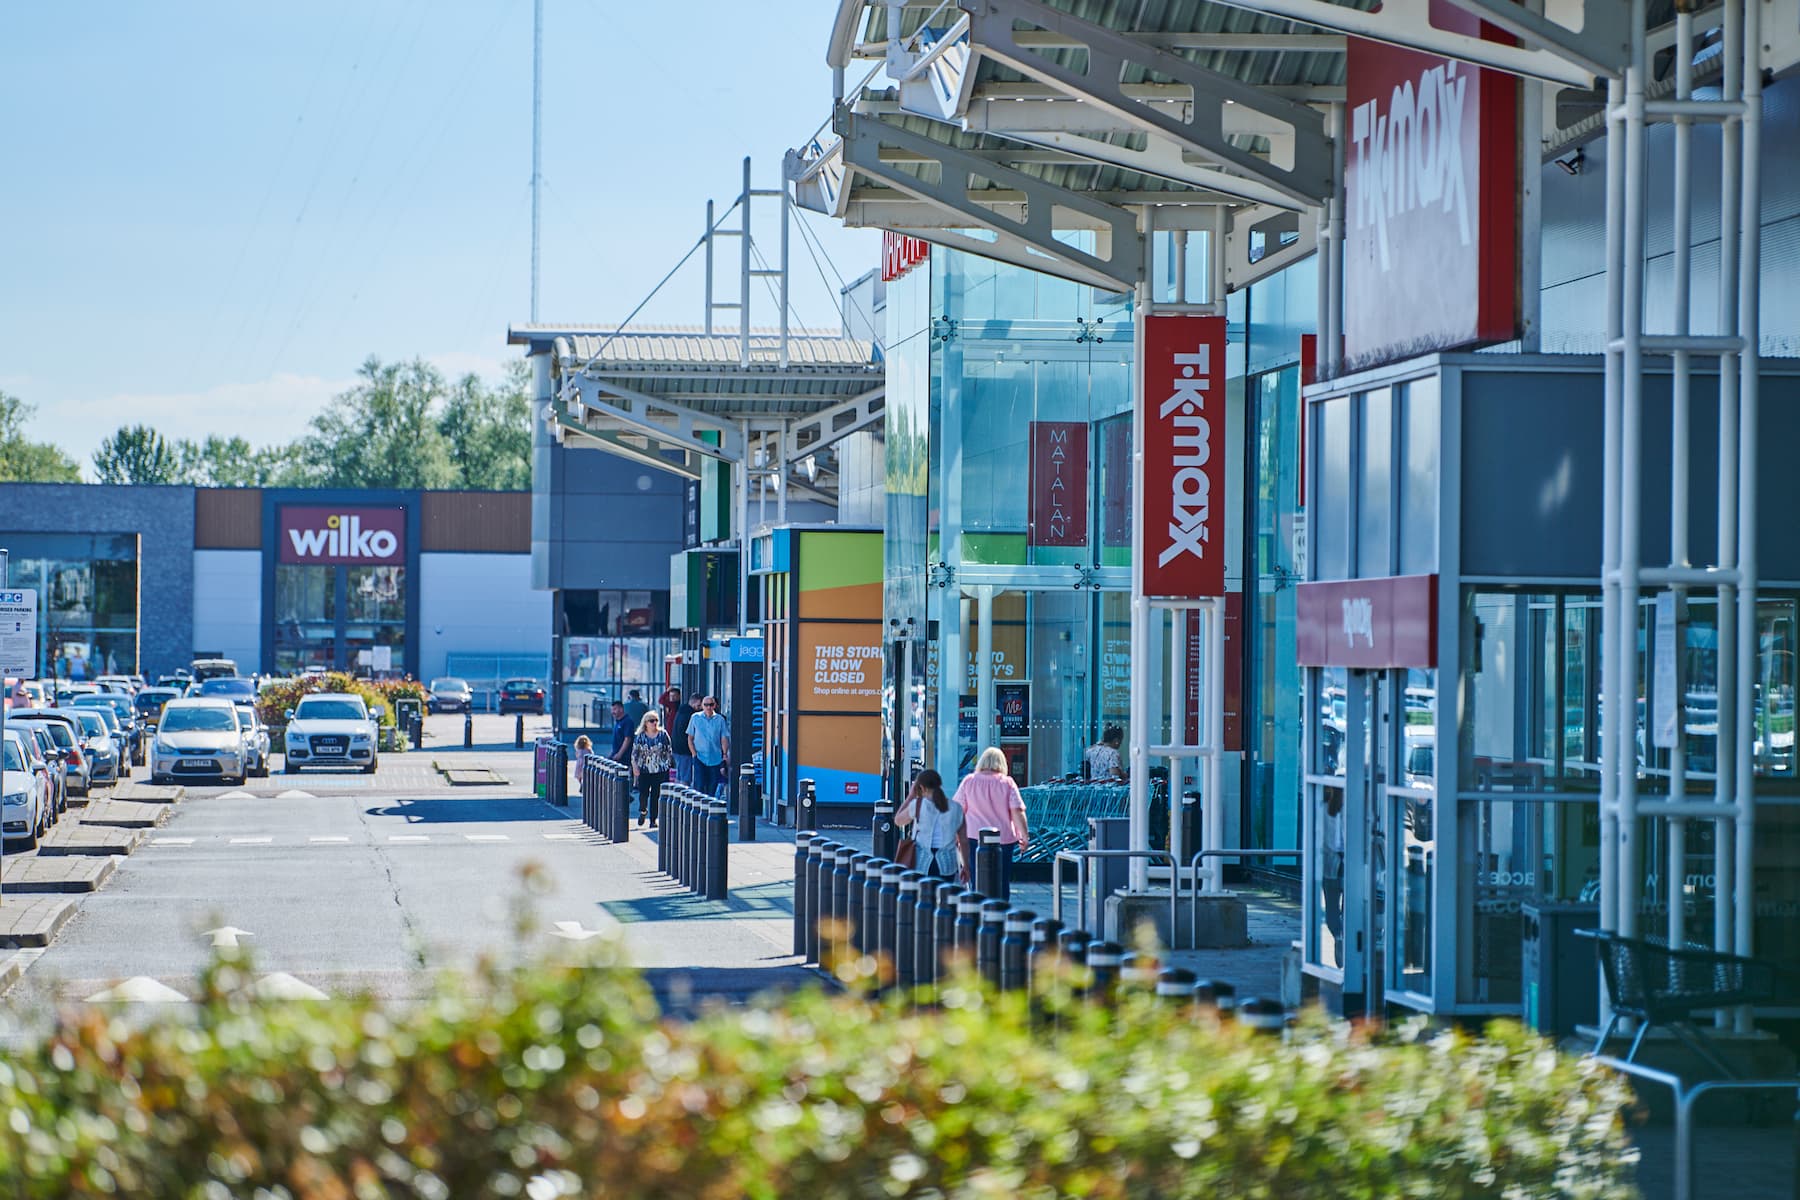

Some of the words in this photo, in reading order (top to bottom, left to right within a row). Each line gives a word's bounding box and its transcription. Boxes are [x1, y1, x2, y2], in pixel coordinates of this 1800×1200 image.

[1050, 430, 1067, 537] MATALAN
[288, 515, 398, 558] wilko
[815, 646, 844, 658] THIS
[815, 659, 828, 670] IS
[830, 659, 863, 671] NOW
[815, 671, 865, 684] CLOSED
[814, 687, 830, 695] Shop
